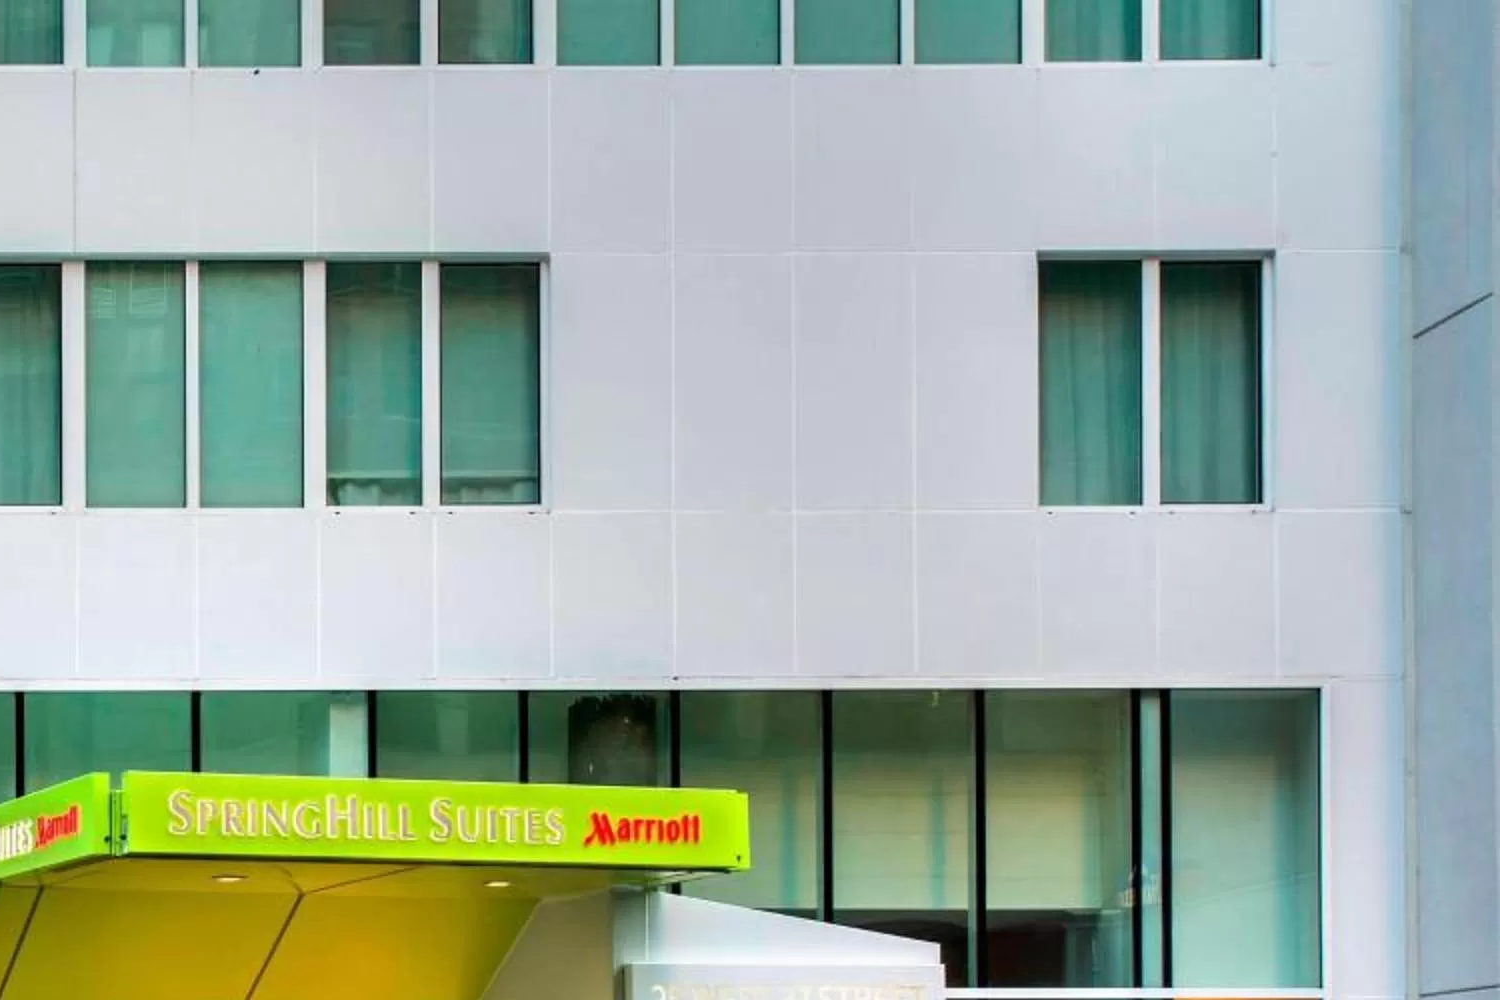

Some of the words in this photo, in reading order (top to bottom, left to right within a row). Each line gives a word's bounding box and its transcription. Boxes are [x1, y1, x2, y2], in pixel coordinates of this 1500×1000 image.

[167, 789, 419, 841] SPRINGHILL
[429, 797, 565, 845] SUITES
[583, 811, 702, 847] Marriott
